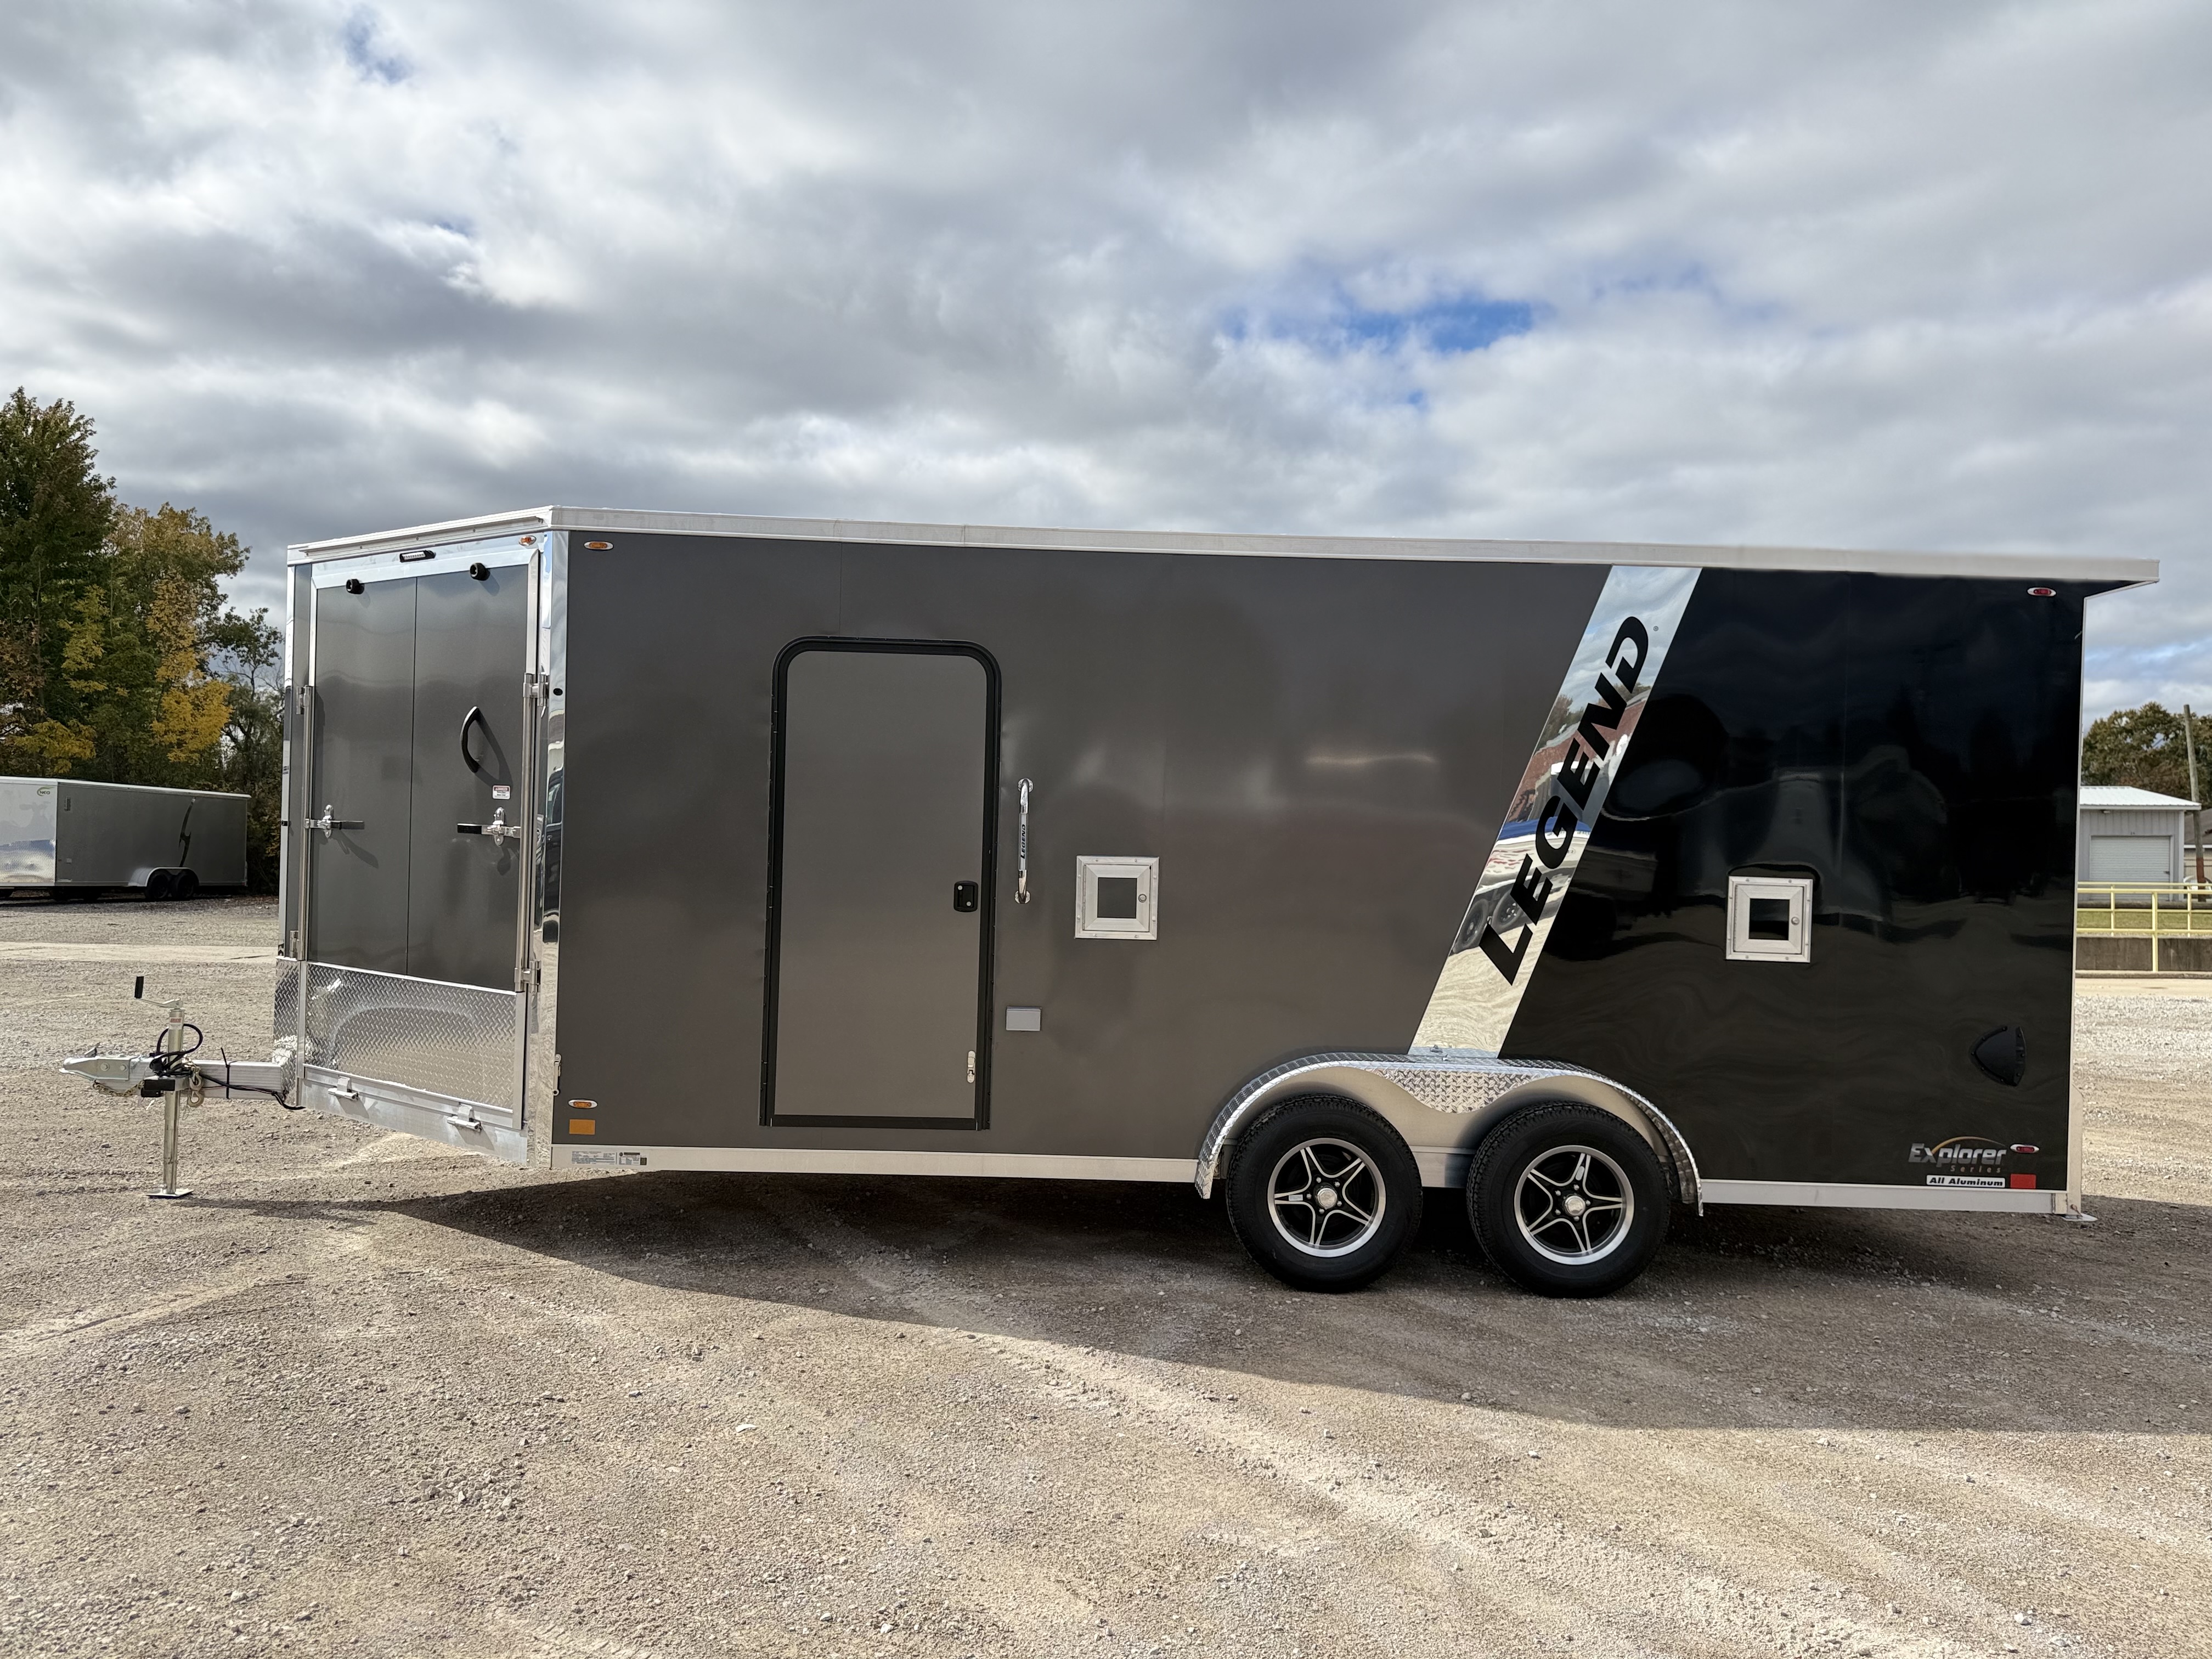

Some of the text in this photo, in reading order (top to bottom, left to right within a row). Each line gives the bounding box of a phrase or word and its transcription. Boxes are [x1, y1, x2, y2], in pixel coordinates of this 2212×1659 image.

[1479, 616, 1648, 986] LEGEND
[1908, 1143, 2007, 1168] Explorer
[1950, 1165, 2001, 1173] Series
[1949, 1177, 2003, 1186] Aluminum
